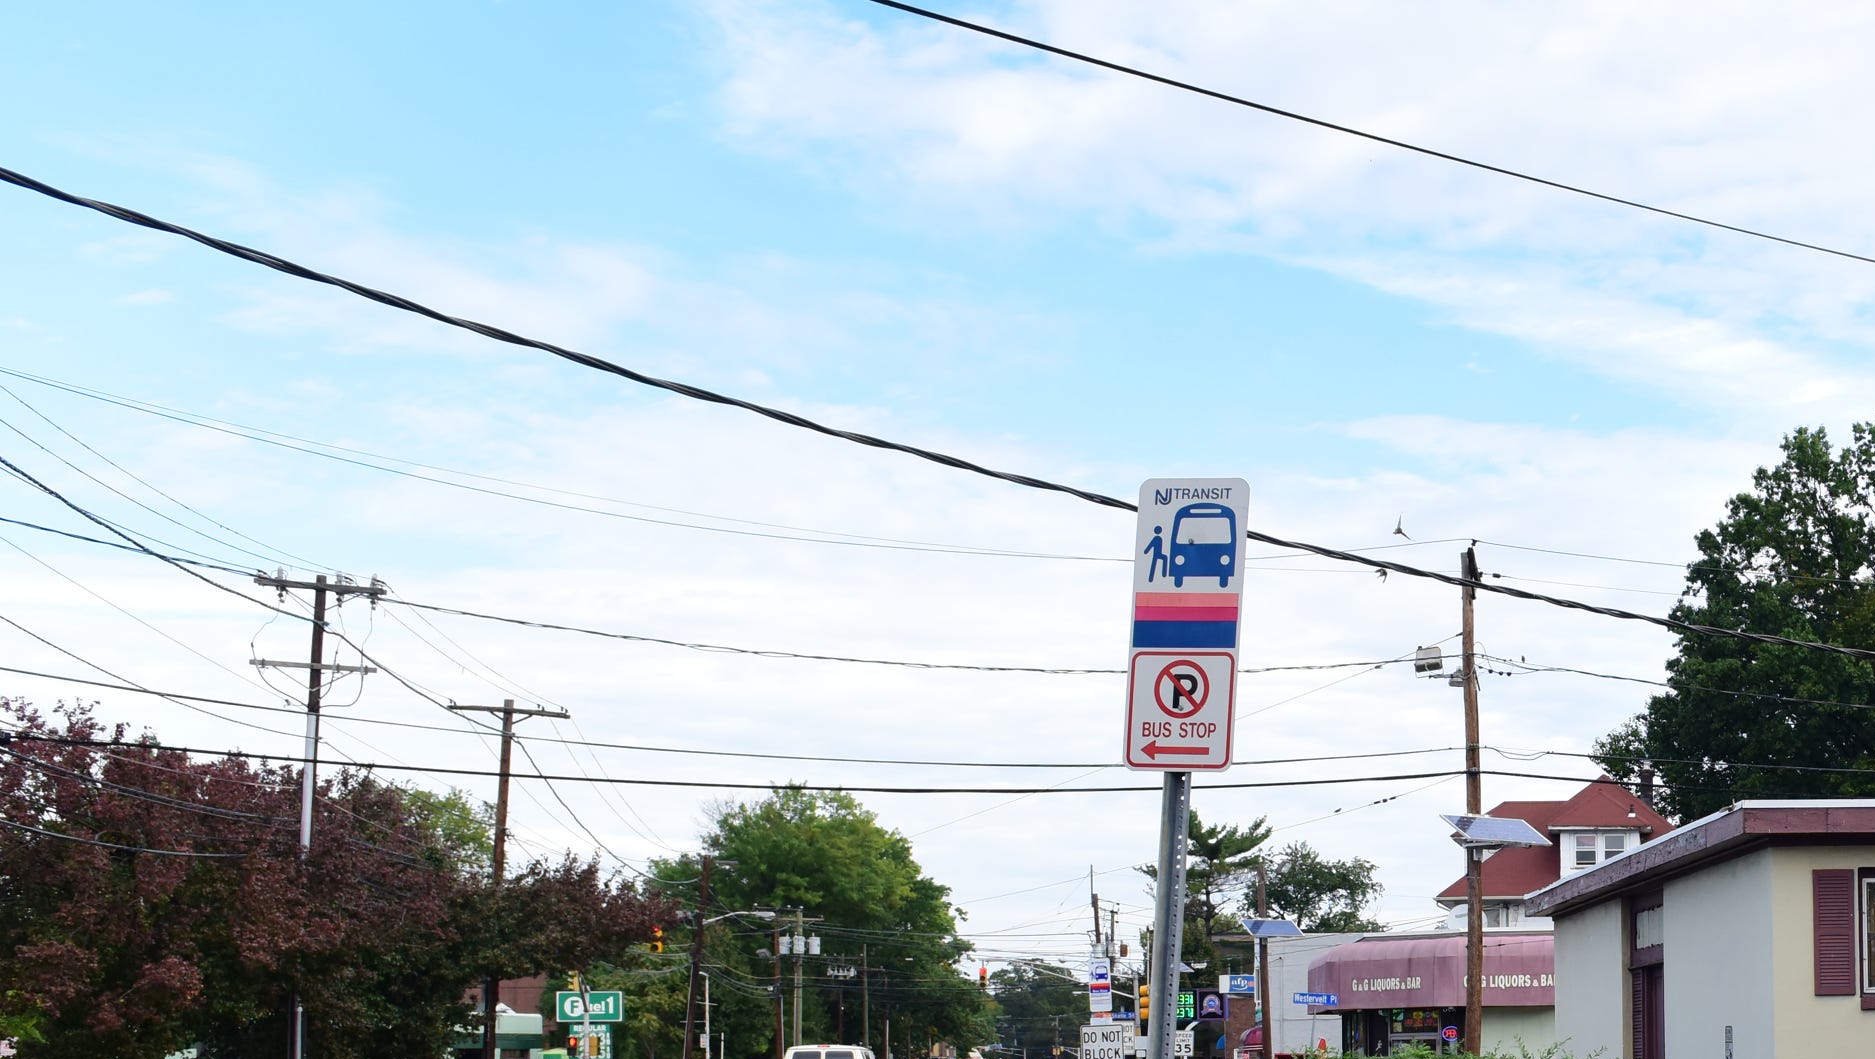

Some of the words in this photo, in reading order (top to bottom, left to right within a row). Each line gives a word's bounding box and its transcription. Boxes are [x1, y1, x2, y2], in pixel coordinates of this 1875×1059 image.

[1173, 488, 1232, 499] TRANSIT
[1142, 721, 1172, 738] BUS
[1179, 722, 1217, 738] STOP
[1370, 978, 1400, 992] LIQUORS
[1406, 977, 1421, 989] BAR
[1489, 975, 1531, 989] LIQUORS
[1540, 974, 1555, 986] BA
[1083, 1032, 1097, 1043] DO
[1102, 1030, 1121, 1043] NOT
[1175, 1043, 1192, 1053] 35
